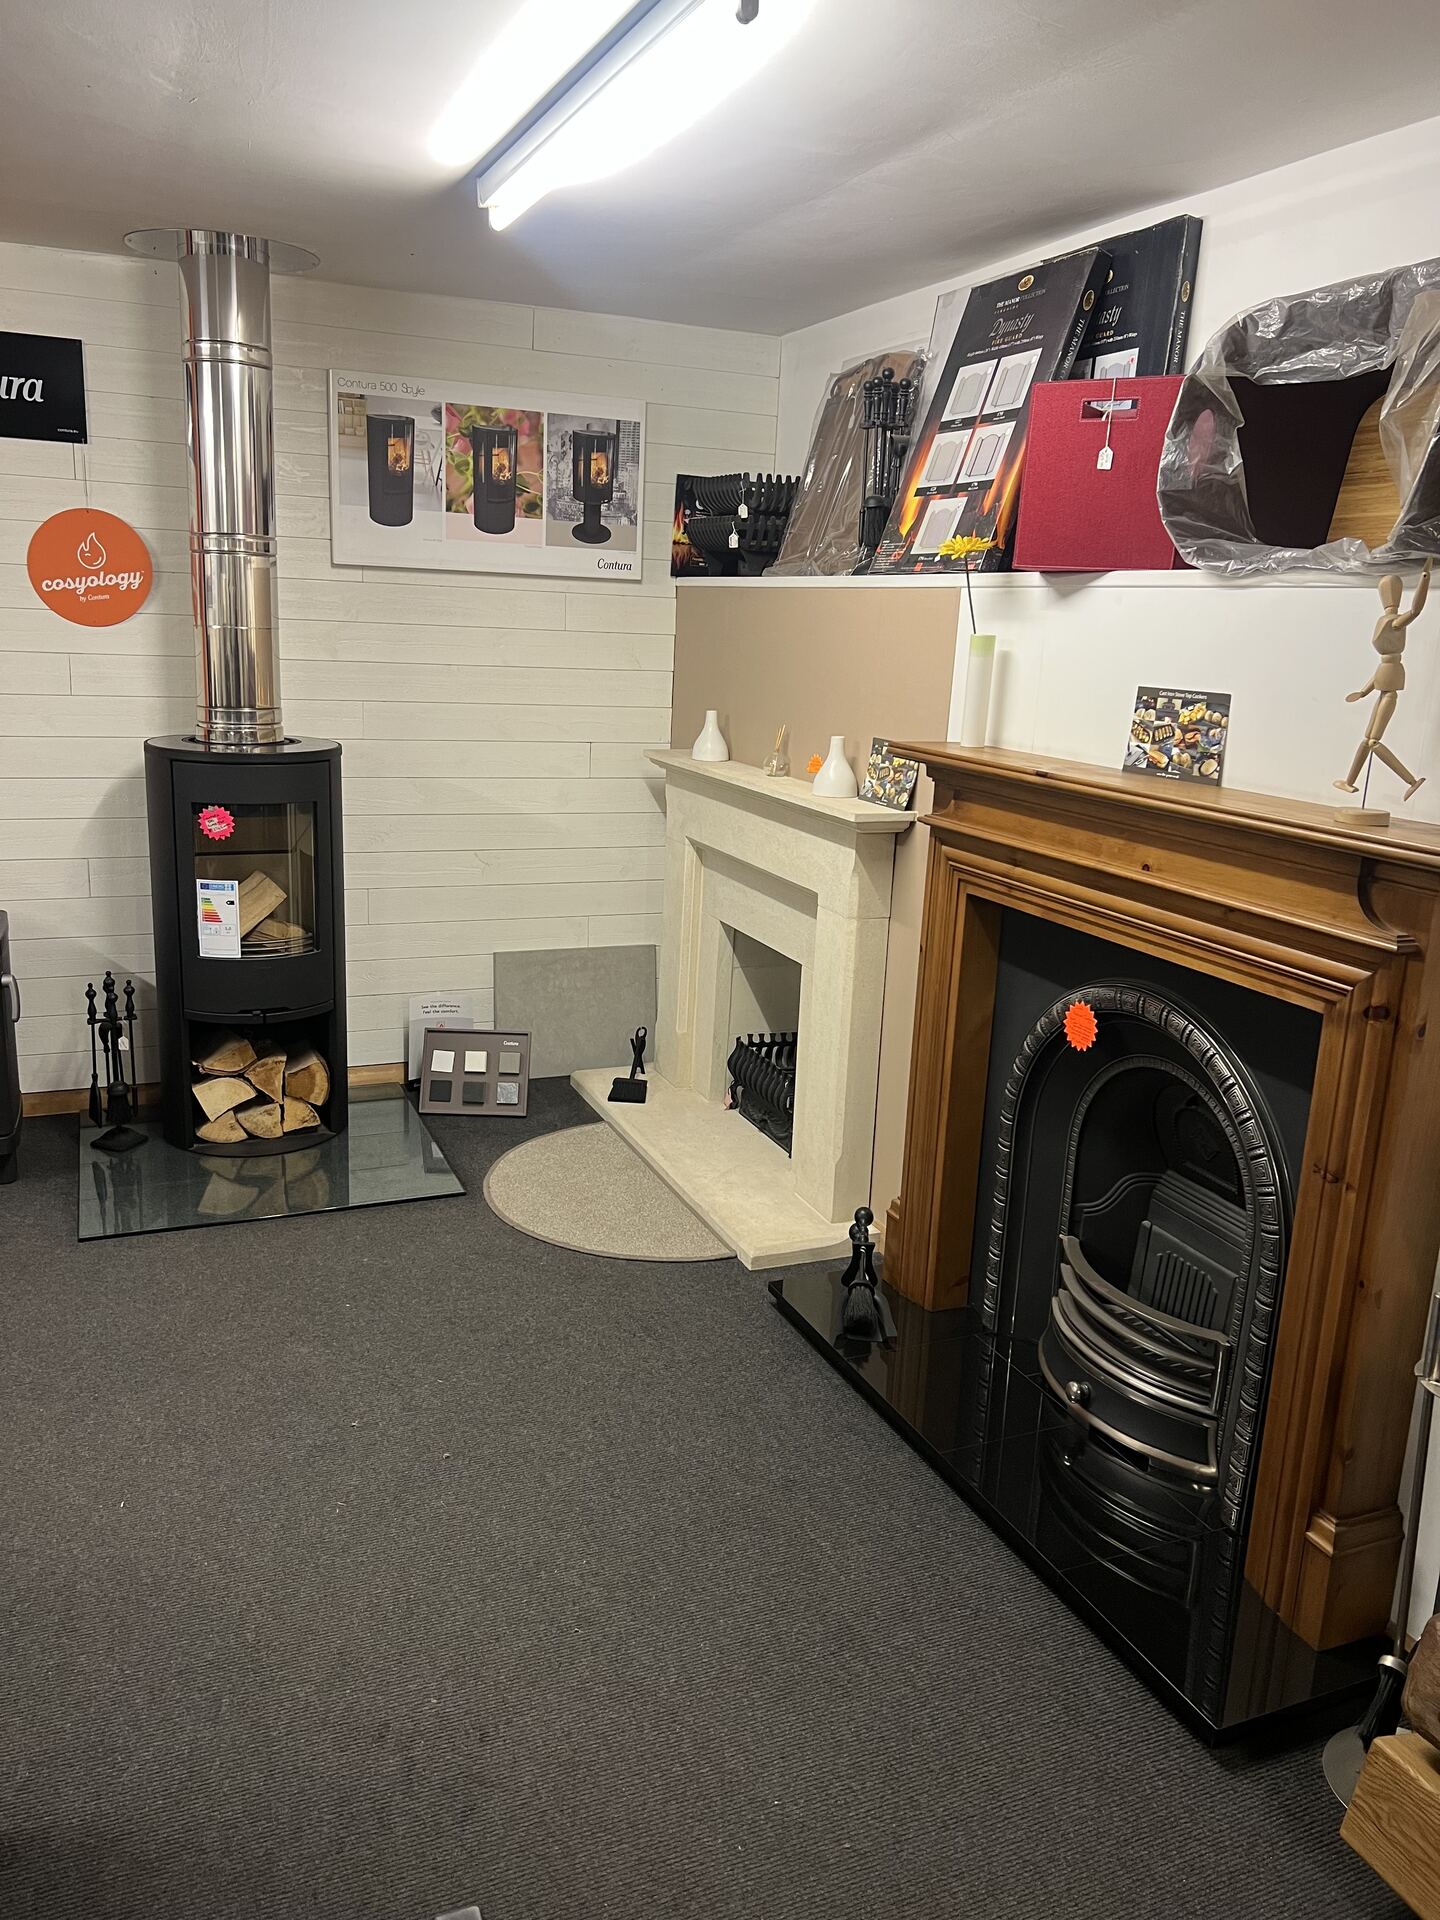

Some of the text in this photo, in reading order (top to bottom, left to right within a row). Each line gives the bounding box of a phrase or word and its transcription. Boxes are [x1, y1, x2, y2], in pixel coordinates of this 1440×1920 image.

[988, 313, 1035, 339] Dynasty
[1063, 318, 1085, 369] THE MANOR
[1173, 330, 1183, 363] MANOR
[337, 377, 425, 397] Contura 500 Style
[597, 557, 632, 571] Contura
[42, 571, 144, 595] cosyology
[79, 593, 110, 603] by Contura
